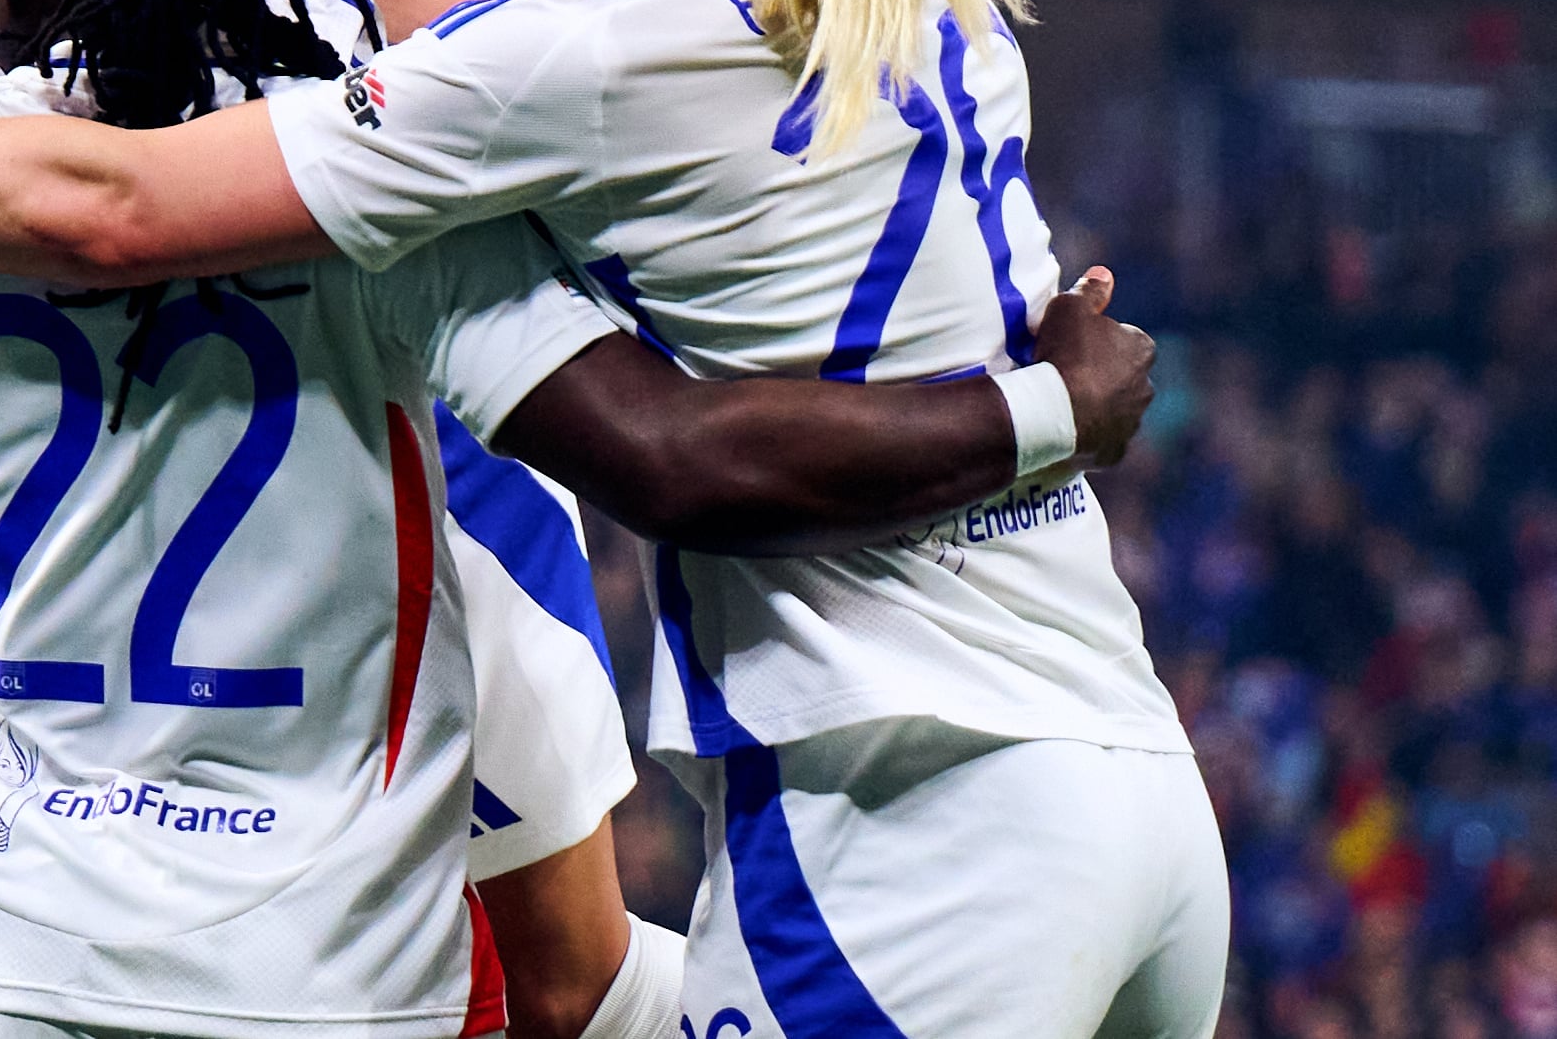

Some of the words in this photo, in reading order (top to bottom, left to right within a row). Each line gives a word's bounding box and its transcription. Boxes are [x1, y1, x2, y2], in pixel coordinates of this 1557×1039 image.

[344, 67, 382, 131] ber
[0, 675, 23, 690] OL
[191, 681, 213, 698] OL
[42, 781, 277, 835] EndoFrance
